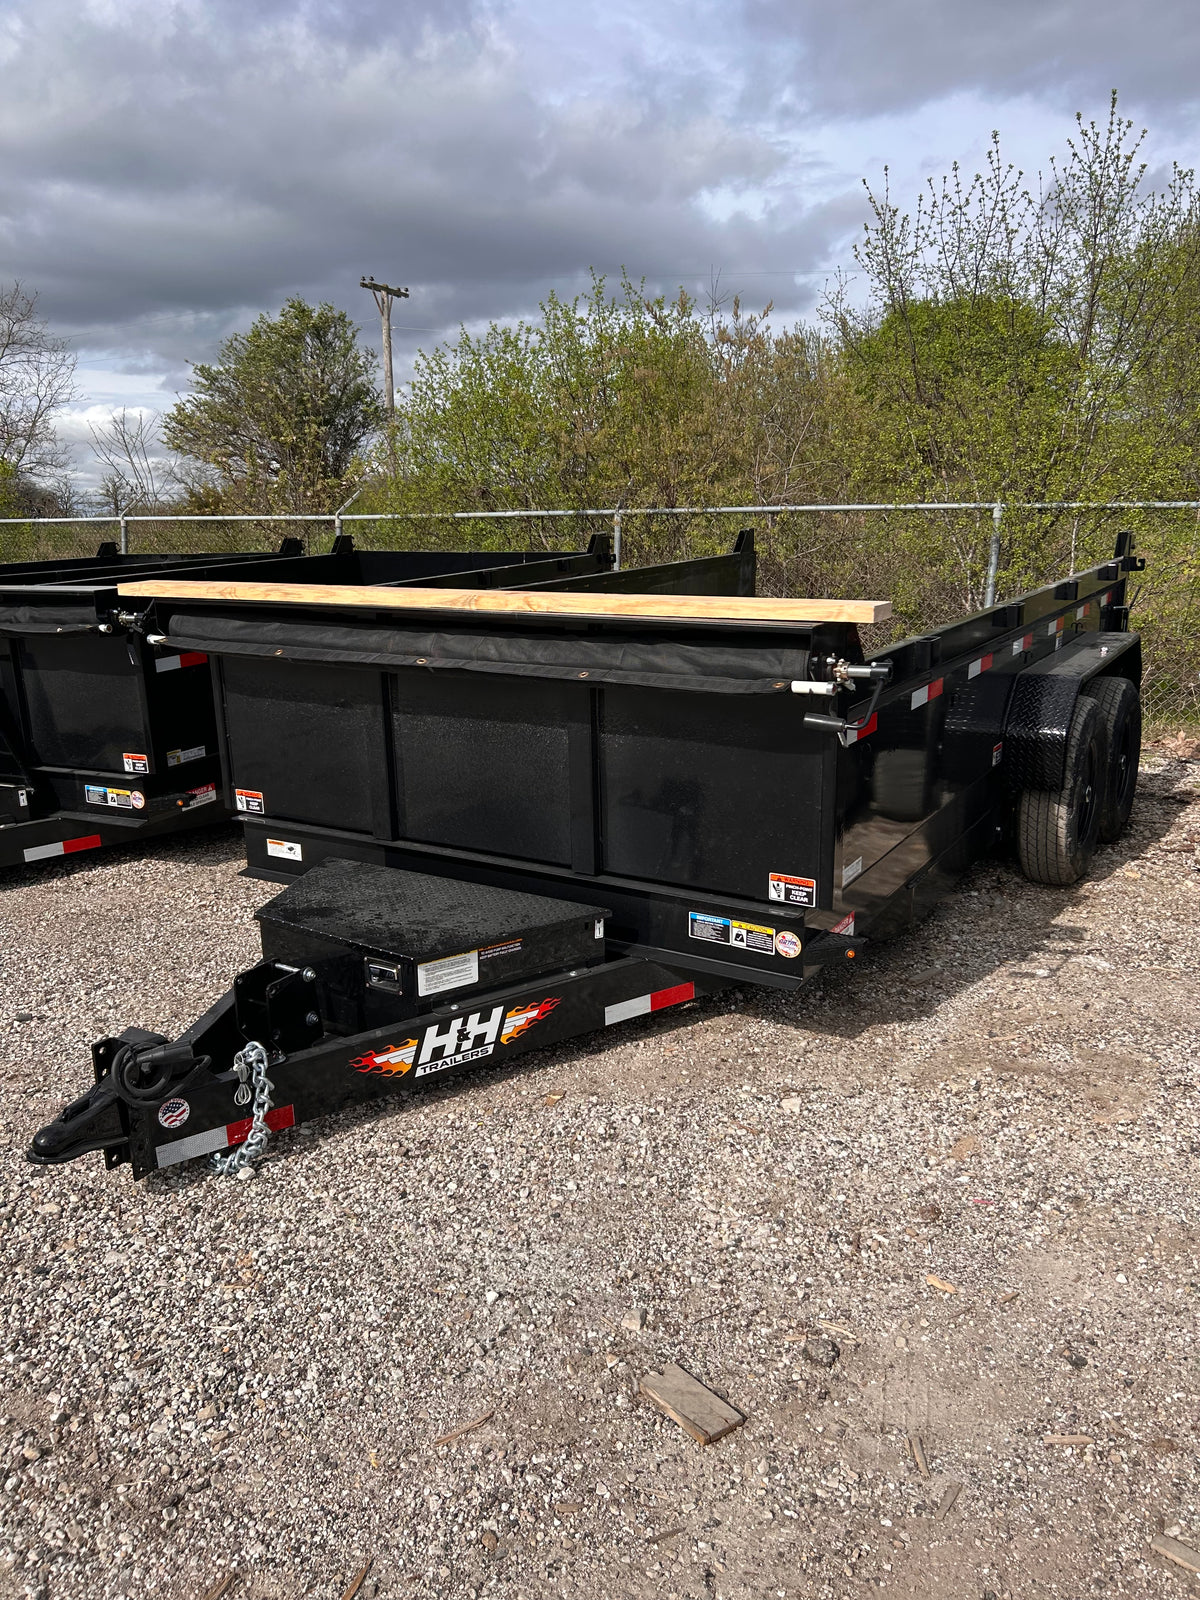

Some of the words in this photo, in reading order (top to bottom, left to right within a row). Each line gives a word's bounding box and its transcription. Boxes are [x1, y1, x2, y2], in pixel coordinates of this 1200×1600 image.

[790, 895, 809, 903] CLEAR
[696, 914, 724, 924] IMPORTANT
[418, 1005, 504, 1065] H&H
[420, 1048, 490, 1075] TRAILERS
